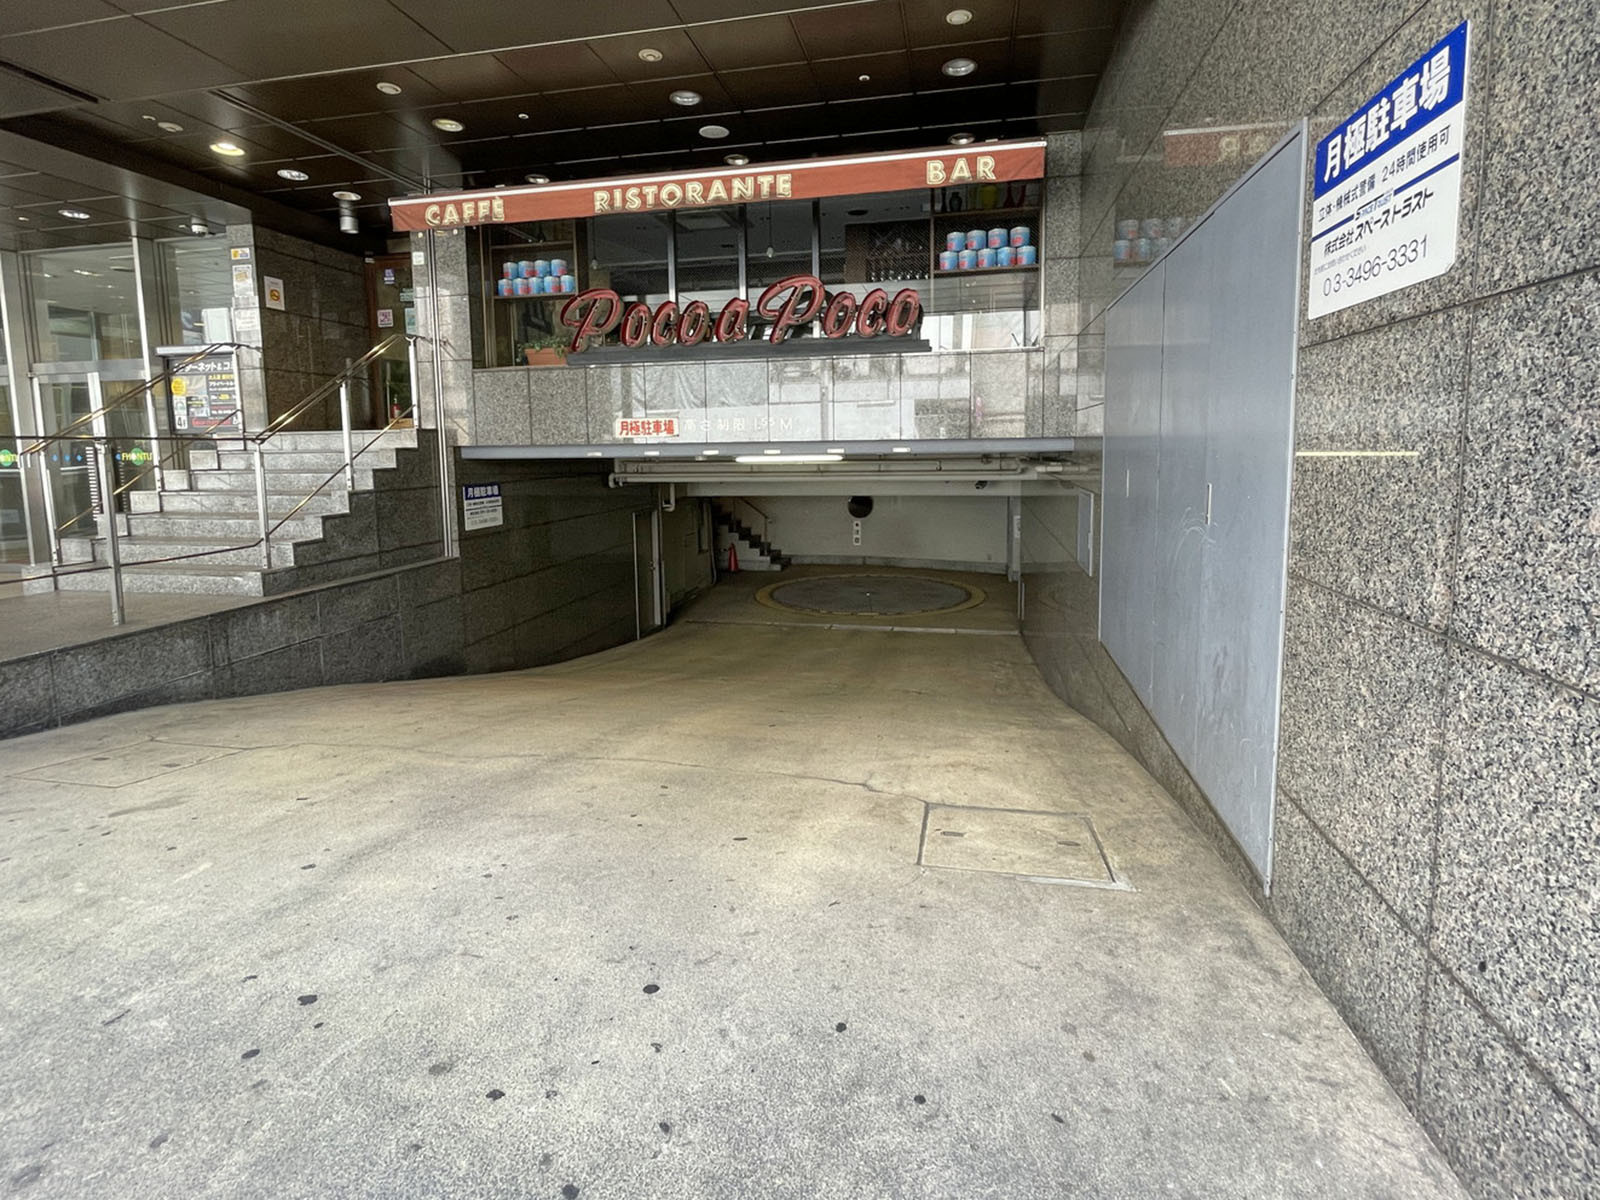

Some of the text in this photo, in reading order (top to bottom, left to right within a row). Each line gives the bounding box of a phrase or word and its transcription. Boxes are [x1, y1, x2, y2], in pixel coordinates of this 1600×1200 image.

[1323, 45, 1450, 184] 月極駐車場
[1382, 124, 1451, 182] 24時間使用可
[594, 173, 792, 213] RISTORANTE
[926, 156, 996, 185] BAR
[1322, 234, 1428, 296] 03-3496-3331
[560, 274, 921, 352] Poco a Poco
[619, 419, 675, 437] 月極駐車場
